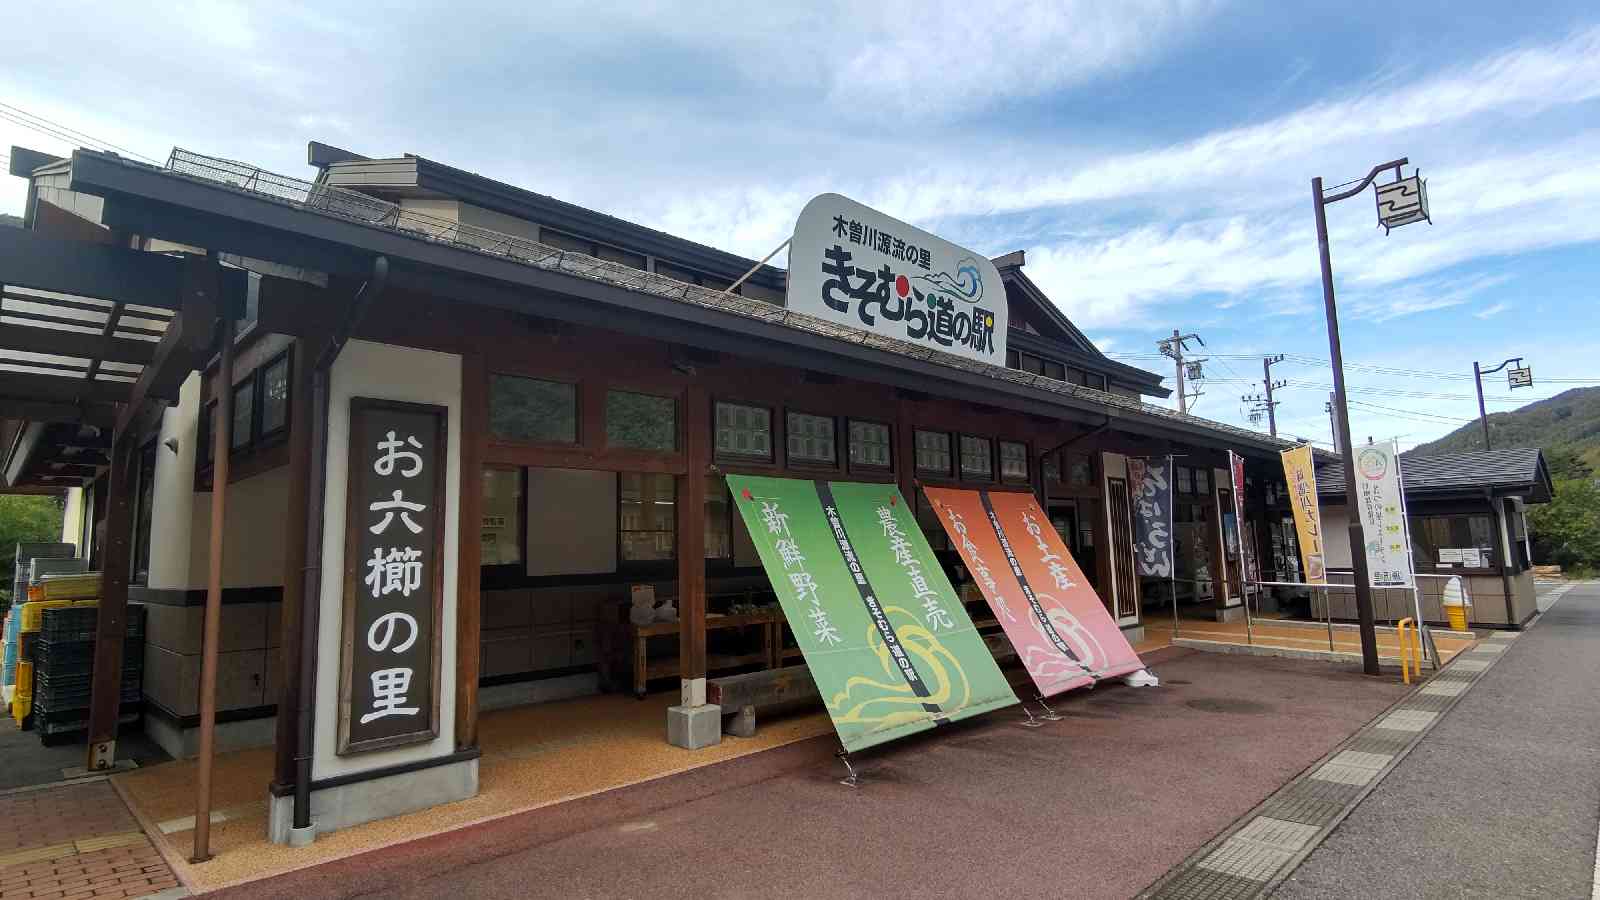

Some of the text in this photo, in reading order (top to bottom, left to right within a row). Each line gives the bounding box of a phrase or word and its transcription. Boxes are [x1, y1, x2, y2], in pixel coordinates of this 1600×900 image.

[821, 245, 995, 356] きそむら道の駅
[832, 214, 932, 271] 木曽川源流の里
[359, 430, 426, 725] お六櫛の里
[761, 501, 842, 648] 新鮮野菜
[875, 505, 954, 632] 農産直売
